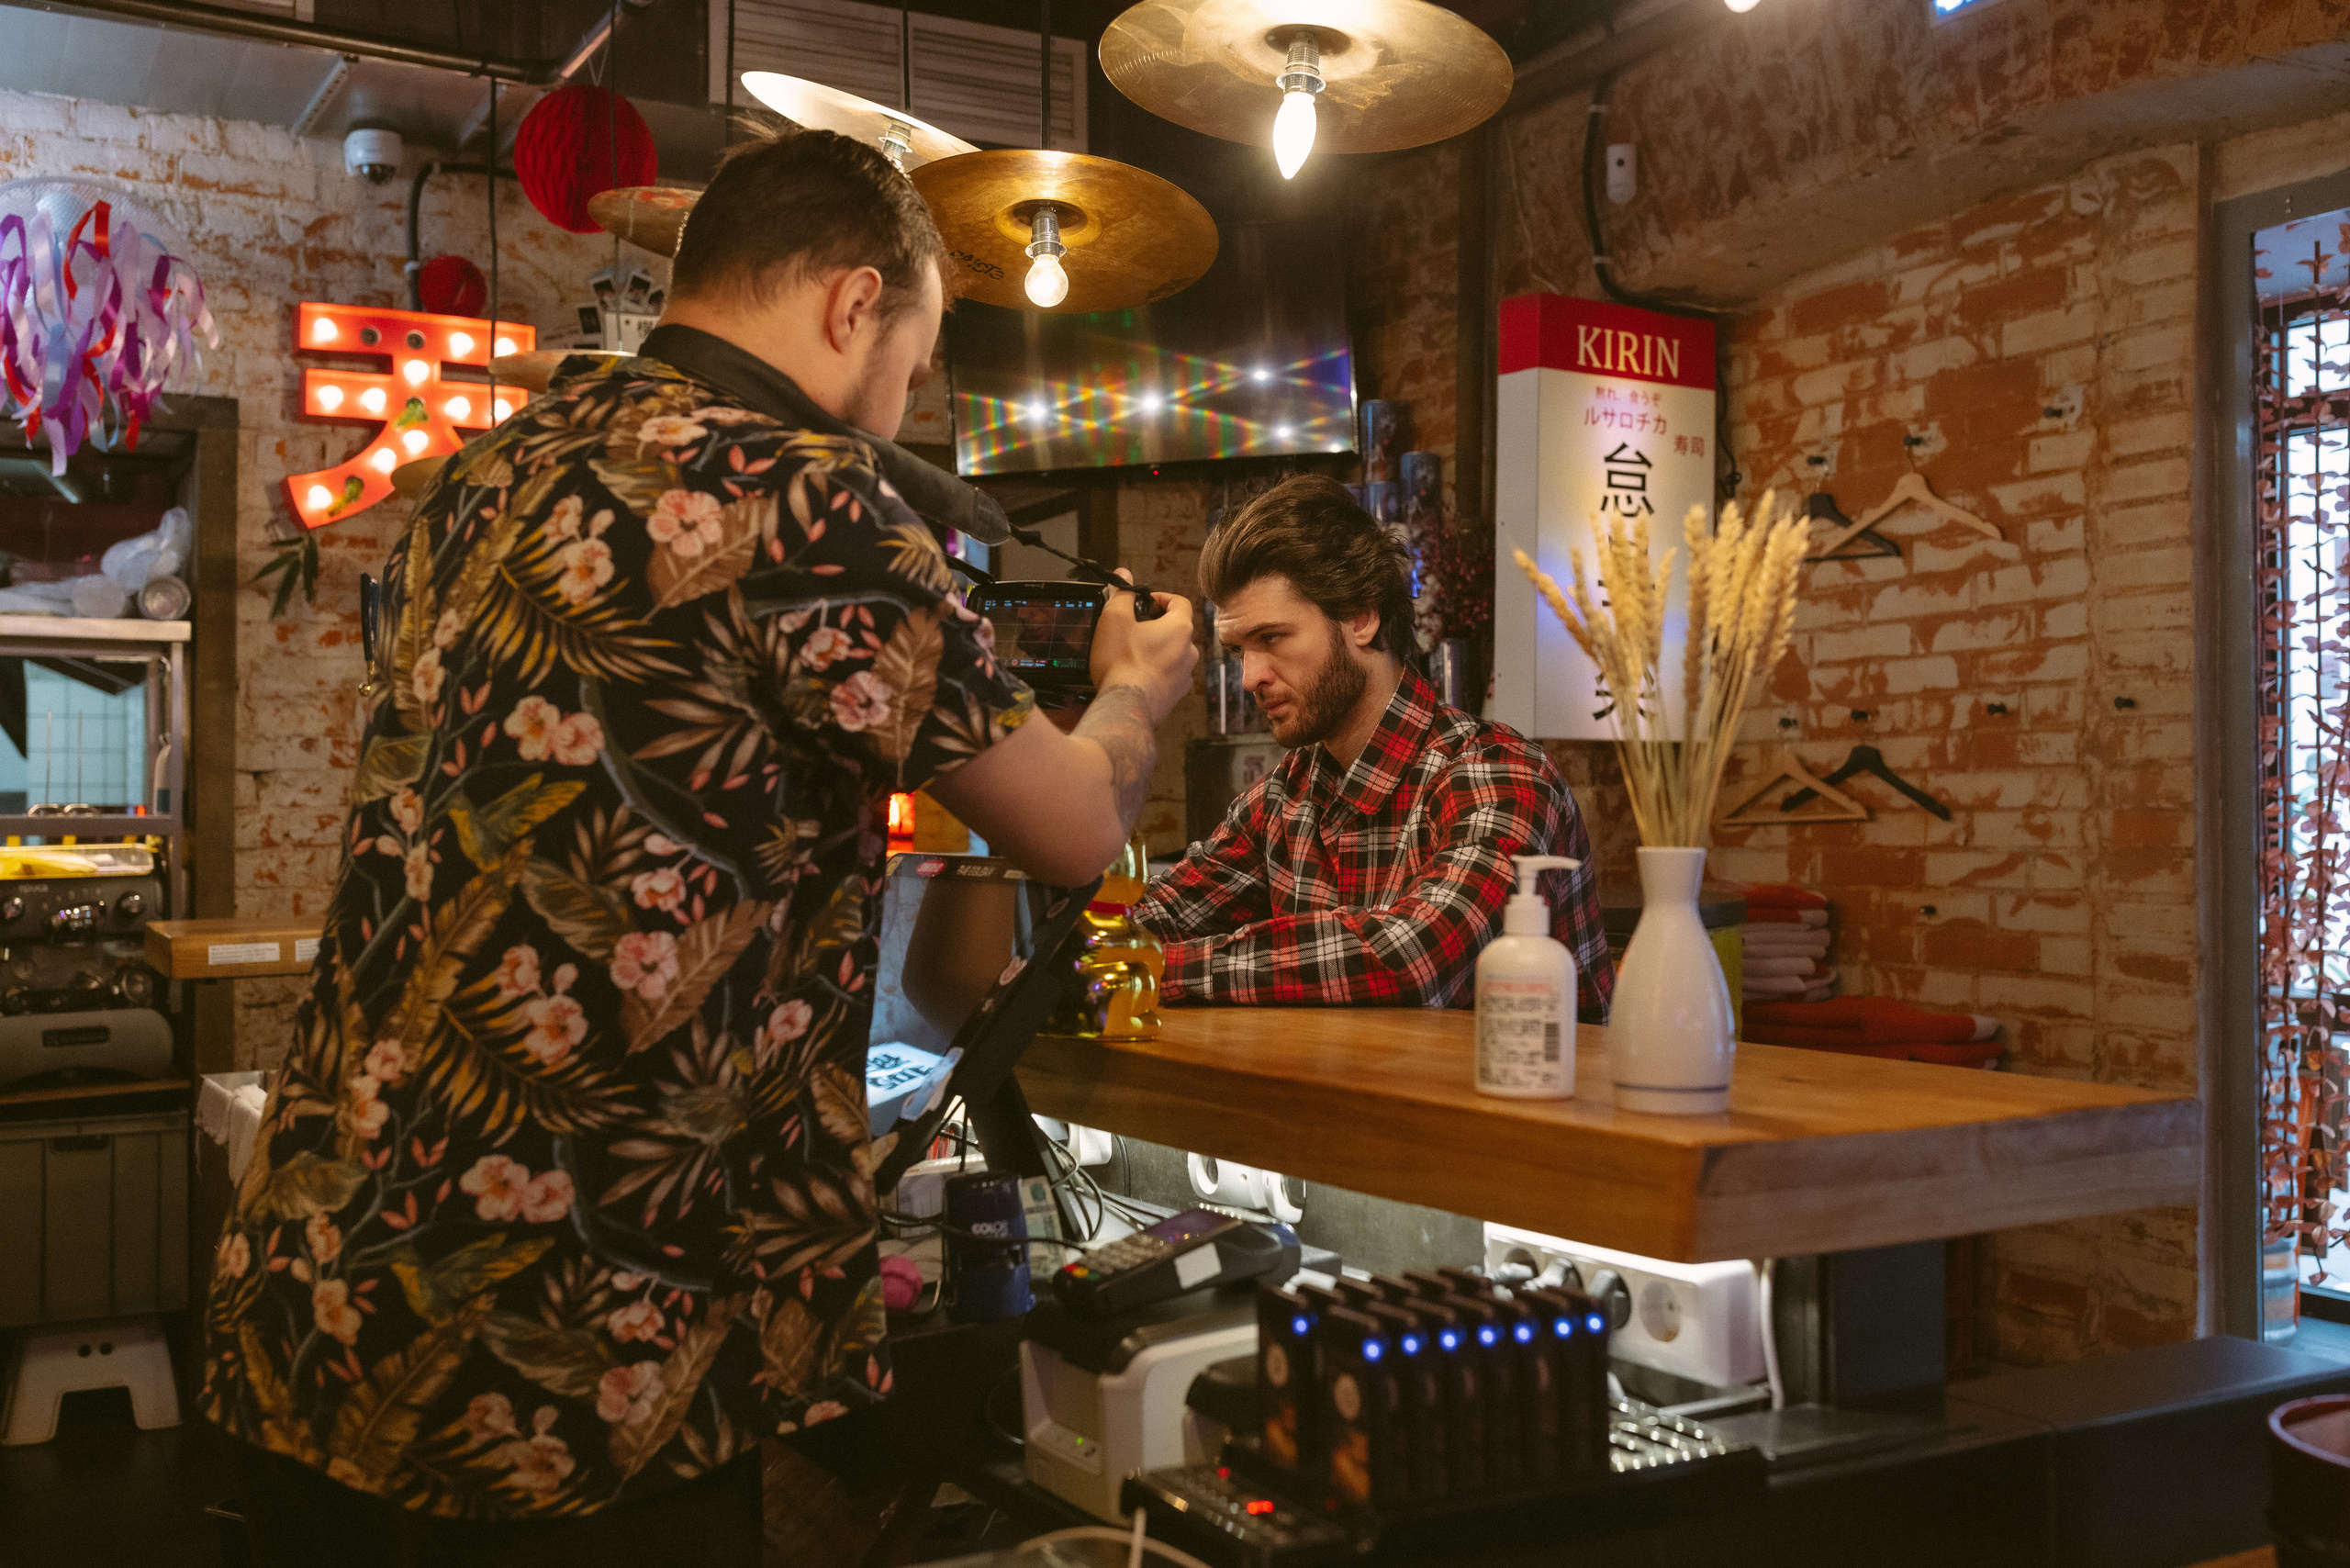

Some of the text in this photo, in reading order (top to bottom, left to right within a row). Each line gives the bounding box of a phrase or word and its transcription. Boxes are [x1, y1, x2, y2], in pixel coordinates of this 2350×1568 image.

[1576, 324, 1680, 379] KIRIN
[1583, 407, 1667, 435] ルサロチカ
[1673, 434, 1706, 458] 寿司
